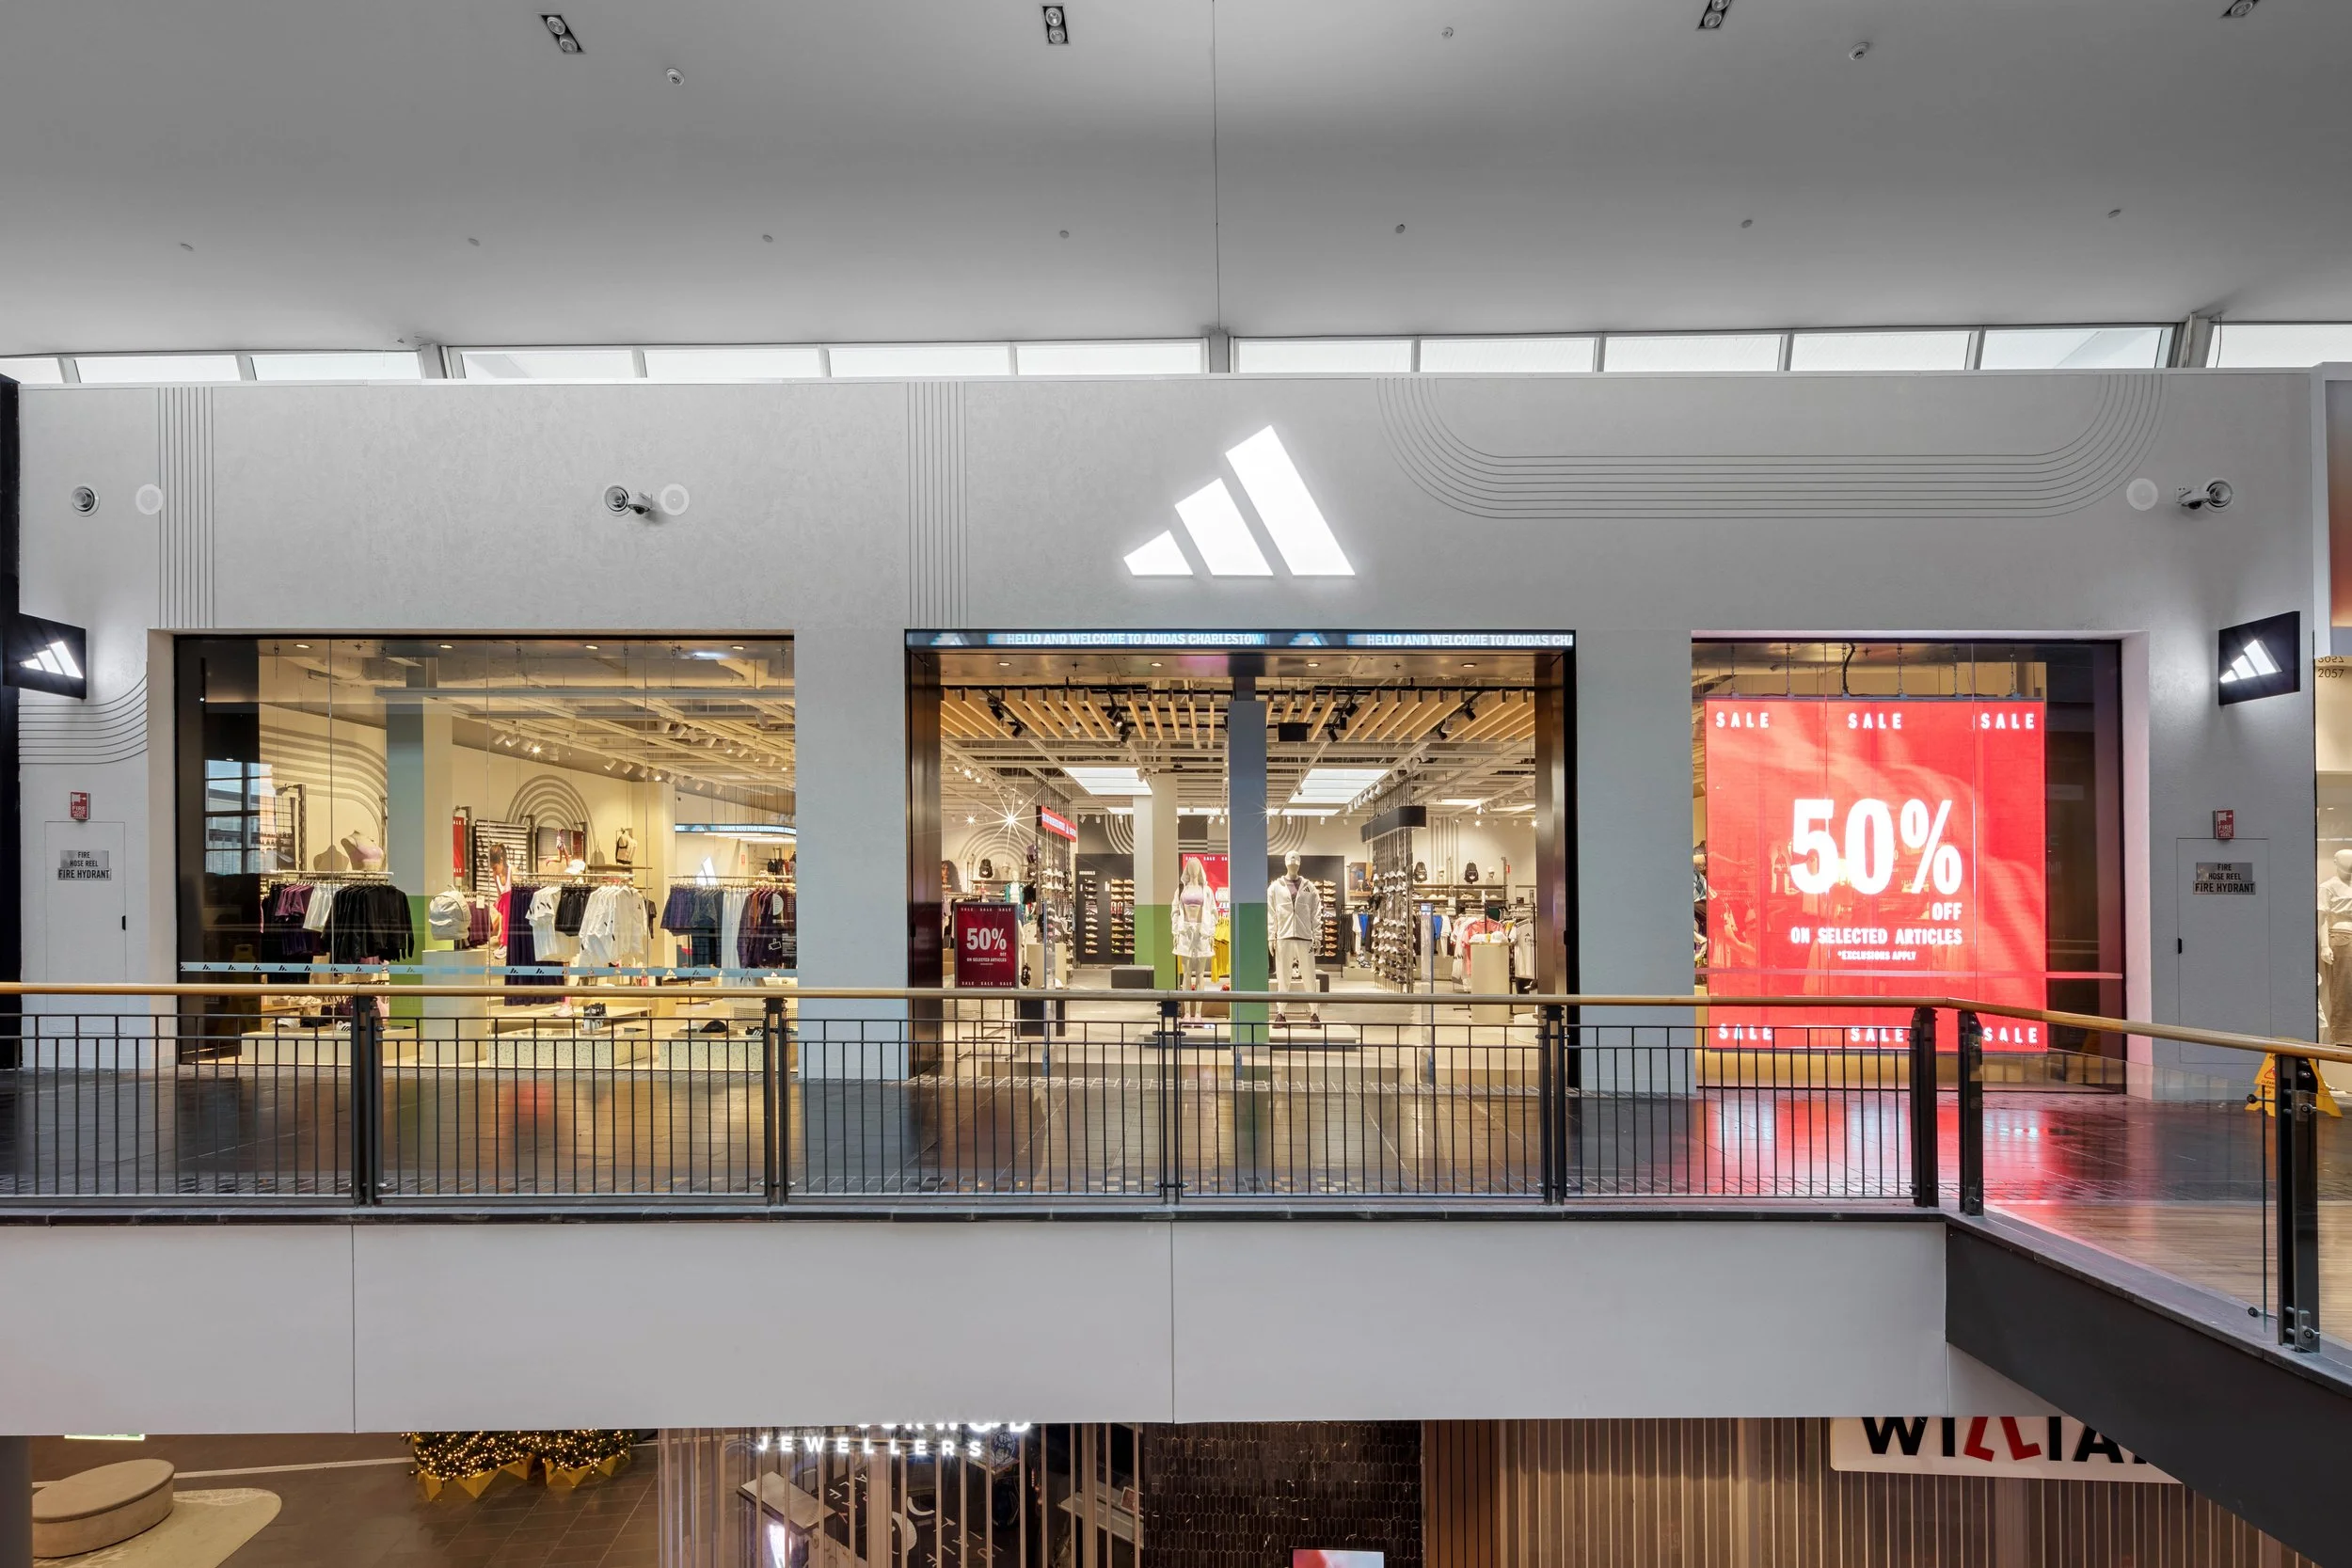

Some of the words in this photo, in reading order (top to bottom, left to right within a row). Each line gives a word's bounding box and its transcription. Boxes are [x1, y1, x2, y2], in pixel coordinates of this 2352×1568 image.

[1007, 634, 1041, 645] HELLO
[1043, 634, 1068, 645] AND
[1069, 634, 1125, 645] WELCOME
[1128, 634, 1141, 645] TO
[1144, 634, 1185, 645] ADIDAS
[1188, 634, 1270, 645] CHARLESTOWN
[1367, 634, 1400, 646] HELLO
[1404, 634, 1429, 646] AND
[1430, 634, 1487, 646] WELCOME
[1490, 634, 1504, 646] TO
[1507, 634, 1548, 646] ADIDAS
[2318, 668, 2344, 678] 2057
[1716, 712, 1770, 729] SALE
[1848, 713, 1902, 729] SALE
[1980, 713, 2035, 729] SALE
[1789, 798, 1963, 895] 50%
[58, 870, 75, 879] FIRE
[77, 870, 110, 879] HYDRANT
[2195, 883, 2214, 892] FIRE
[2217, 883, 2255, 893] HYDRANT
[1931, 902, 1963, 921] OFF
[966, 928, 1007, 950] 50%
[1790, 927, 1811, 944] ON
[1817, 927, 1888, 945] SELECTED
[1895, 928, 1963, 946] ARTICLES
[1892, 951, 1916, 961] APPLY
[1718, 1024, 1773, 1041] SALE
[1850, 1025, 1904, 1042] SALE
[1983, 1027, 2038, 1044] SALE
[757, 1435, 982, 1457] JEWELLERS
[1861, 1417, 2147, 1464] WILLIA
